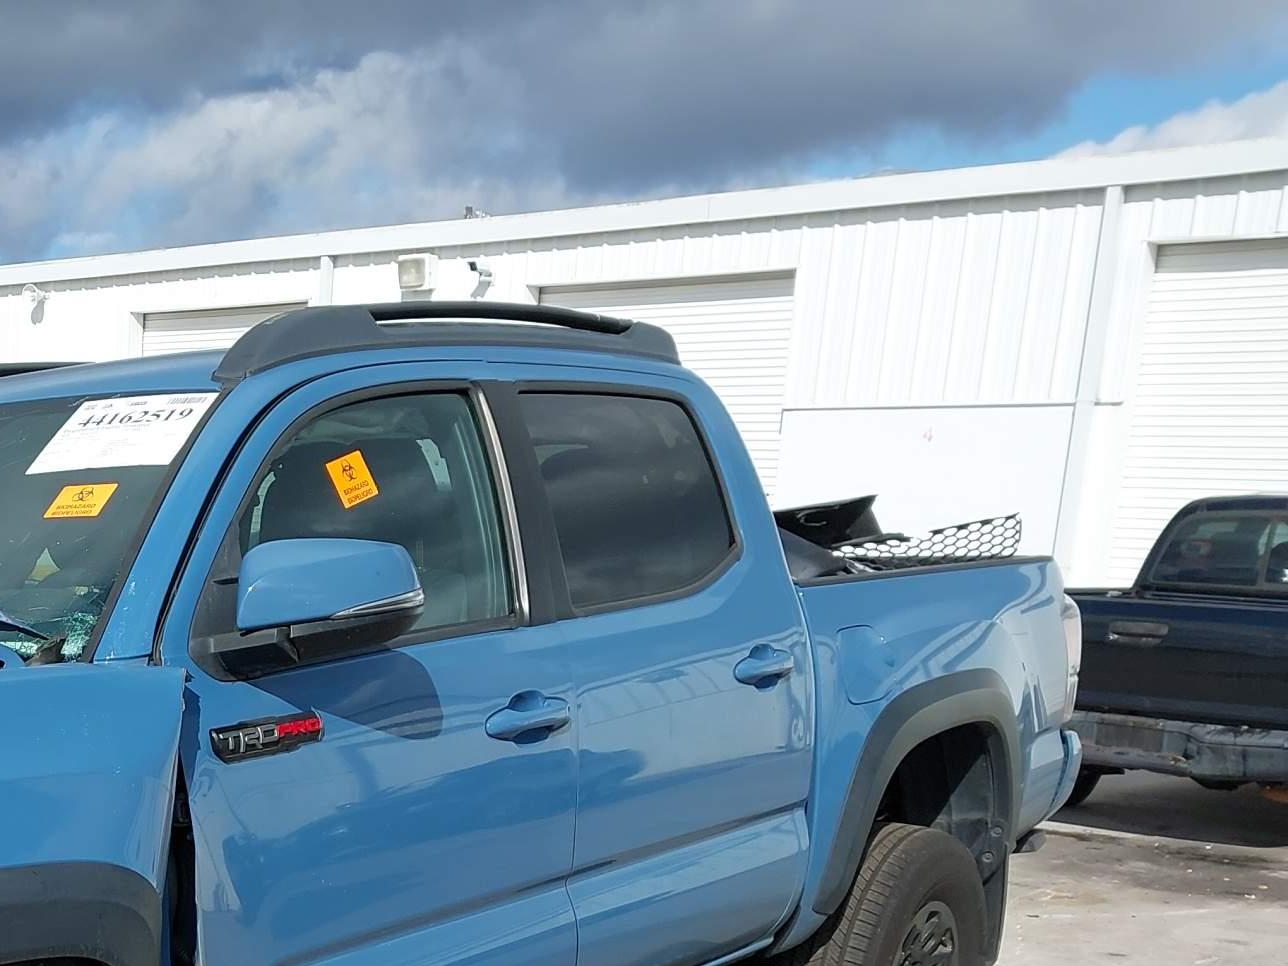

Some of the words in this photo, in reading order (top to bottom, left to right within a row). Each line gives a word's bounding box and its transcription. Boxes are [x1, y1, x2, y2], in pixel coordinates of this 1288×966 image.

[78, 408, 194, 428] 44162519
[343, 480, 370, 496] BIOHAZARD
[219, 724, 279, 752] TRD
[278, 718, 320, 738] PRO
